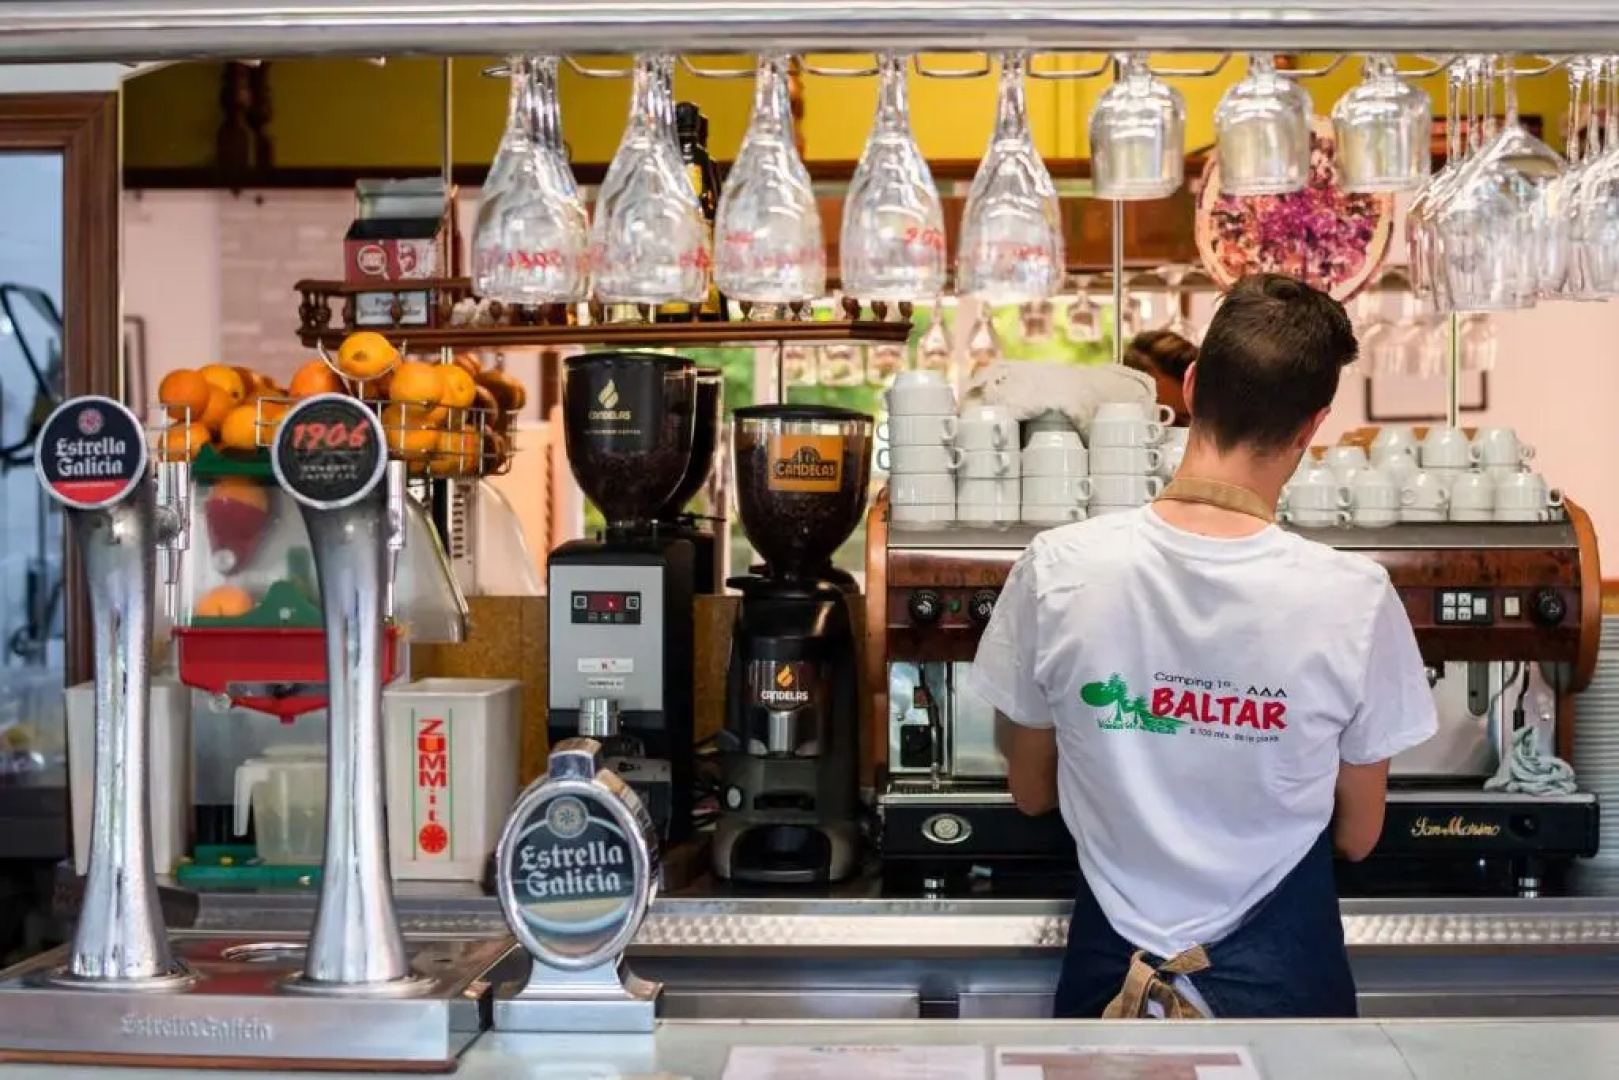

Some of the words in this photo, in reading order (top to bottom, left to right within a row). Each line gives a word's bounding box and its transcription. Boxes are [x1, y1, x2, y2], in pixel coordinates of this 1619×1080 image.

[293, 419, 369, 450] 1906
[56, 437, 126, 456] Estrella
[57, 456, 124, 477] Galicia
[775, 462, 836, 479] CANDELAS
[1153, 671, 1213, 690] Camping
[761, 690, 809, 701] CANDELAS
[1151, 687, 1288, 730] BALTAR
[521, 840, 624, 871] Estrella
[526, 867, 621, 897] Galicia
